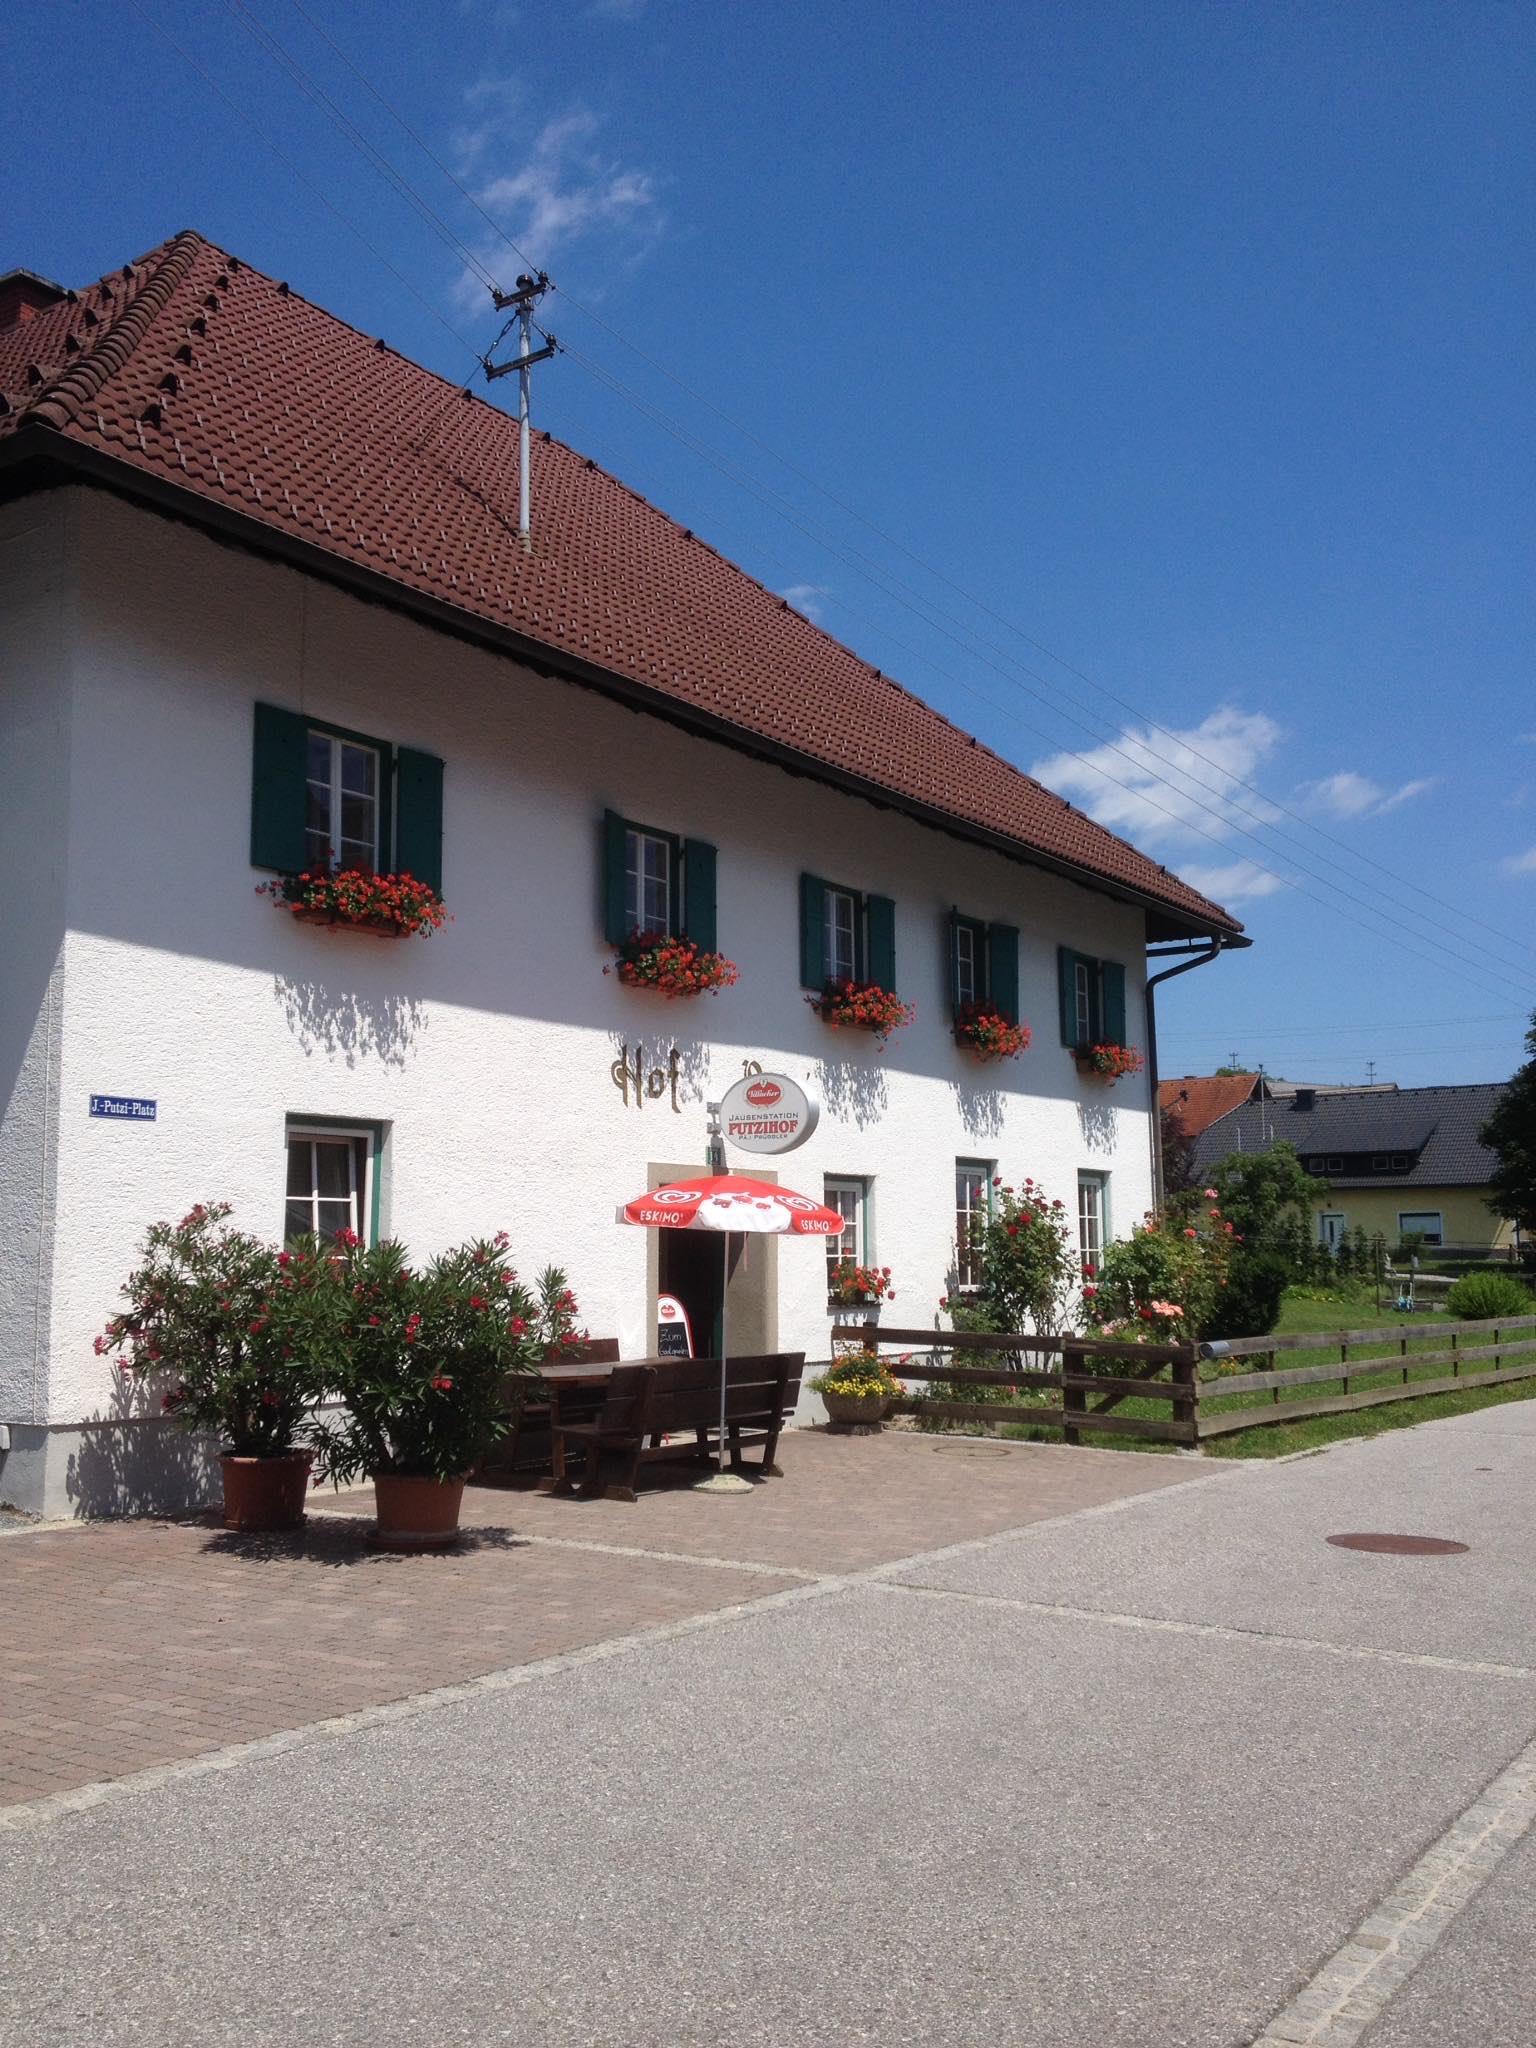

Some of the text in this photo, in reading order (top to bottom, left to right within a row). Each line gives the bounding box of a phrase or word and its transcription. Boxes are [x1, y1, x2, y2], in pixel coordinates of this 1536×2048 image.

[91, 1099, 155, 1116] J.-Putzi-Platz
[728, 1112, 799, 1122] JAUSENSTATION
[728, 1119, 798, 1136] PUTZIHOF
[640, 1210, 680, 1224] ESKIMO
